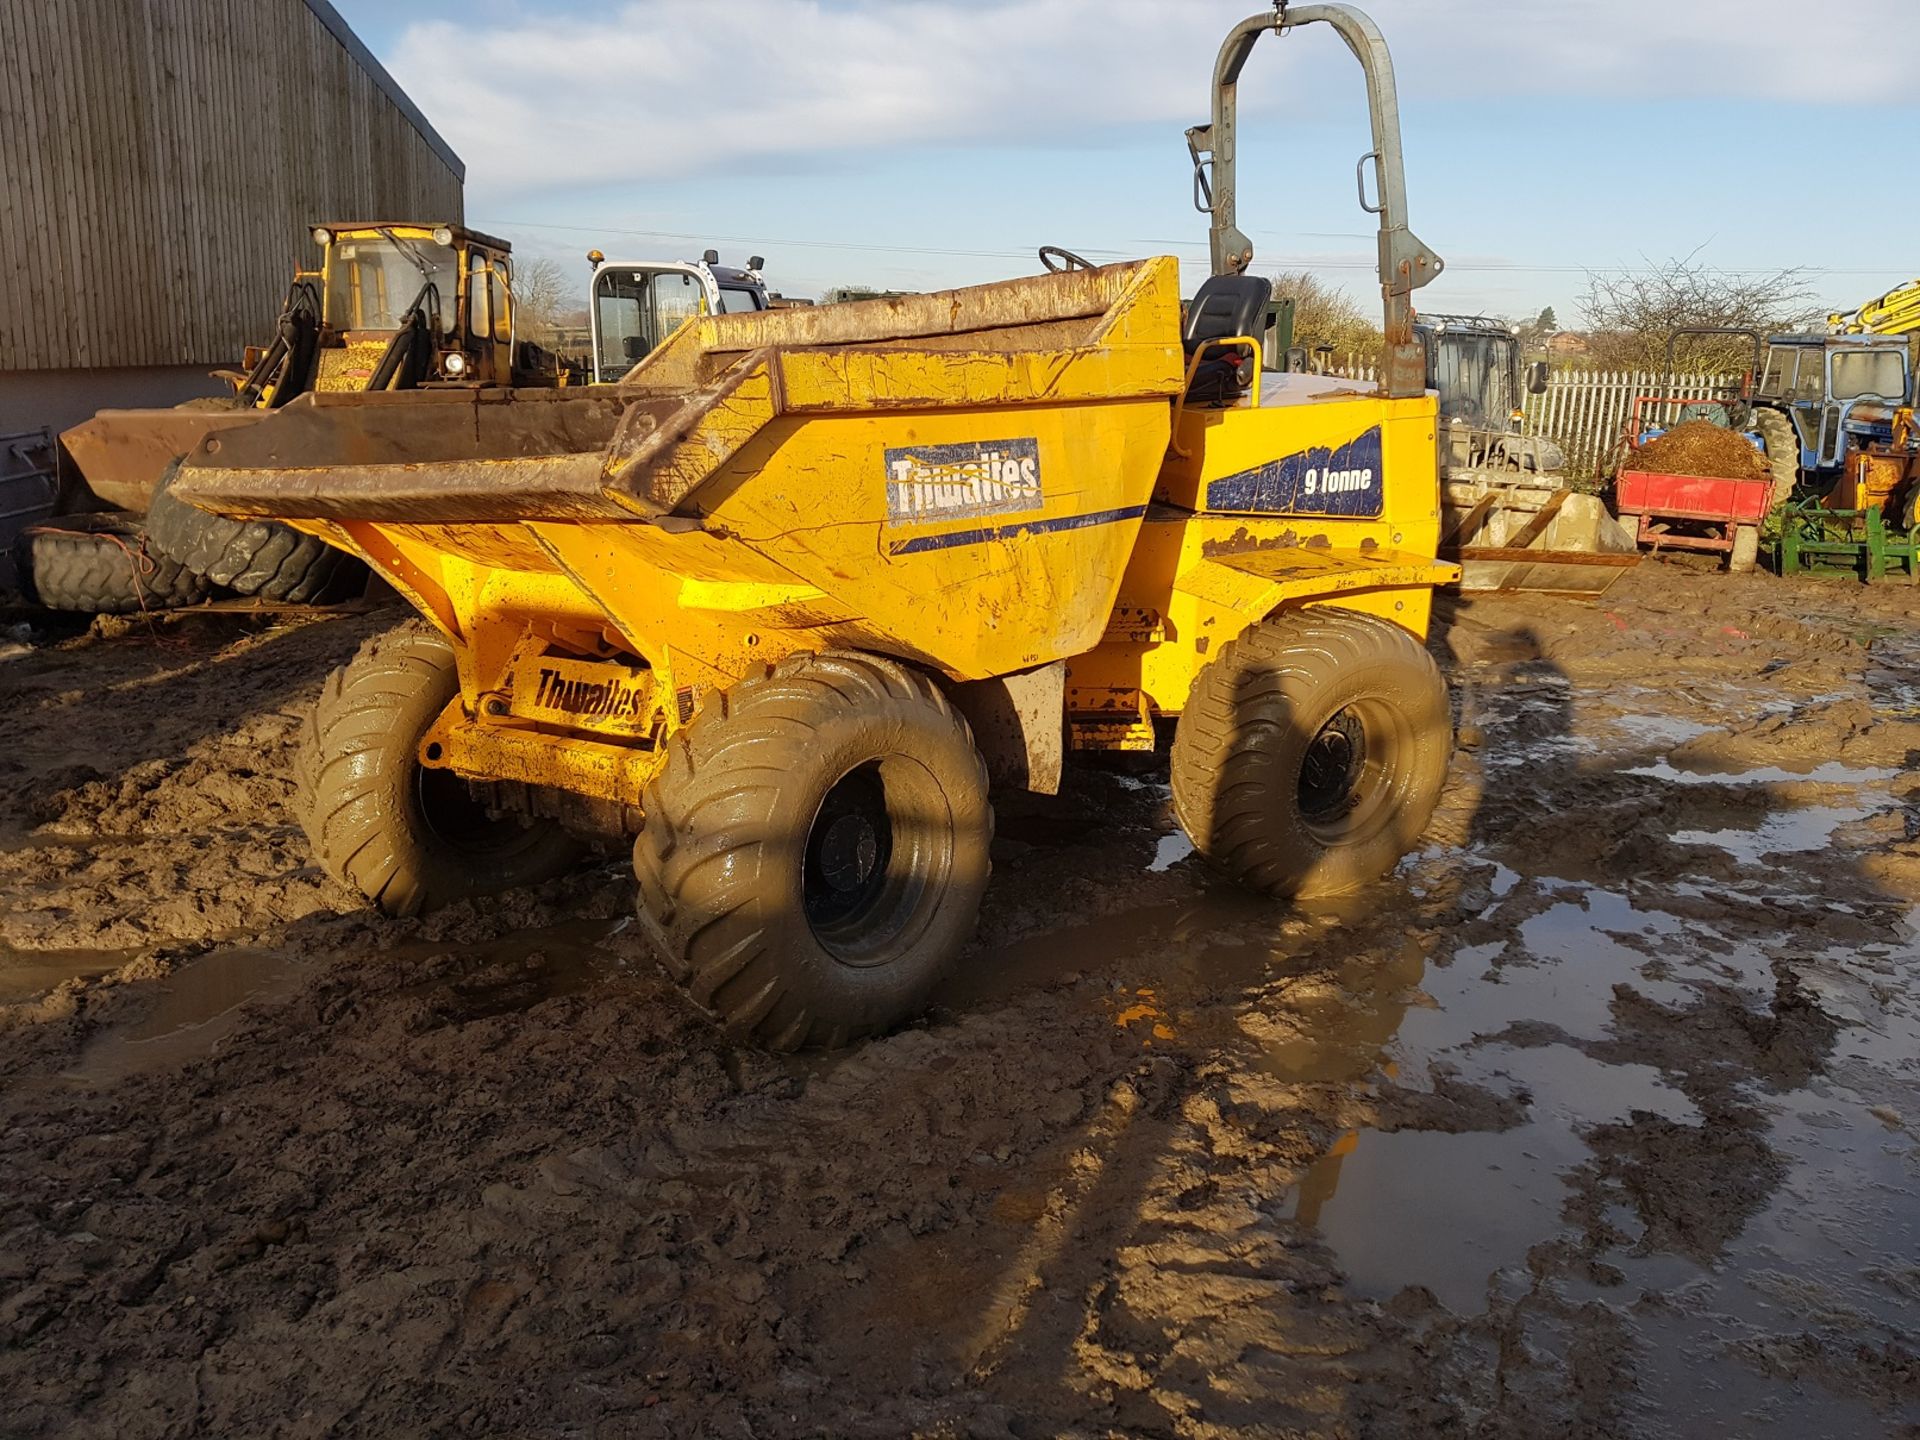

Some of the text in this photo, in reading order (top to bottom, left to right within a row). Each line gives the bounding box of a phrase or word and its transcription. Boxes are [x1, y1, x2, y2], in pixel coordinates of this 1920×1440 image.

[892, 451, 1038, 513] Thwaites
[1304, 467, 1372, 495] 9 tonne
[534, 669, 645, 722] Thwaites
